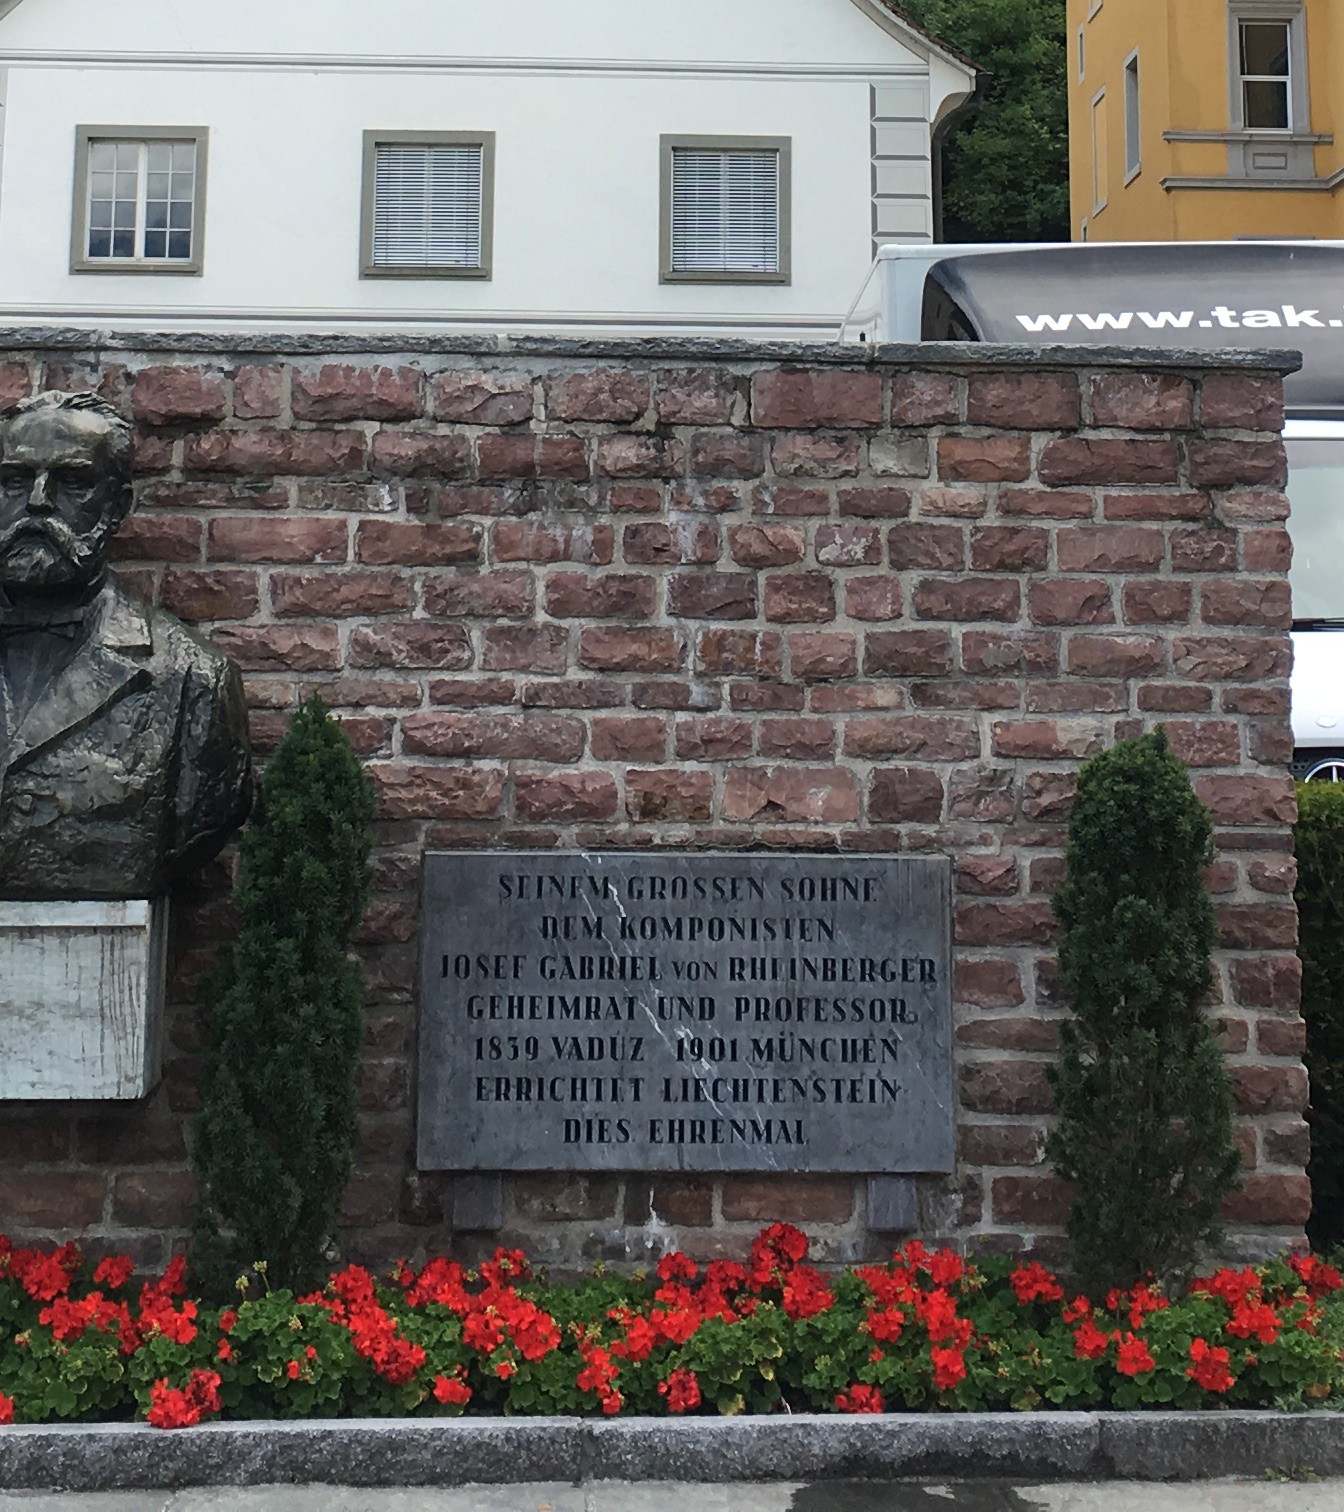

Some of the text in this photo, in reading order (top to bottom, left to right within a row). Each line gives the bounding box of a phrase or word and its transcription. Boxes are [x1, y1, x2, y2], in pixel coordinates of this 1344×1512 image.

[498, 874, 878, 903] SEINEM GROSSEN SOHNE
[541, 915, 835, 942] DEM KOMPONISTEN
[440, 954, 937, 983] JOSEF GABRIEL VON RHEINBERGER
[466, 995, 908, 1024] GEHEIMRAT UND PROFESSOR
[475, 1030, 898, 1064] 1839 VADUZ 1901 MÜNCHEN
[475, 1076, 899, 1104] ERRICHTET LIECHTENSTEIN
[563, 1118, 808, 1145] DIES EHRENMAL
